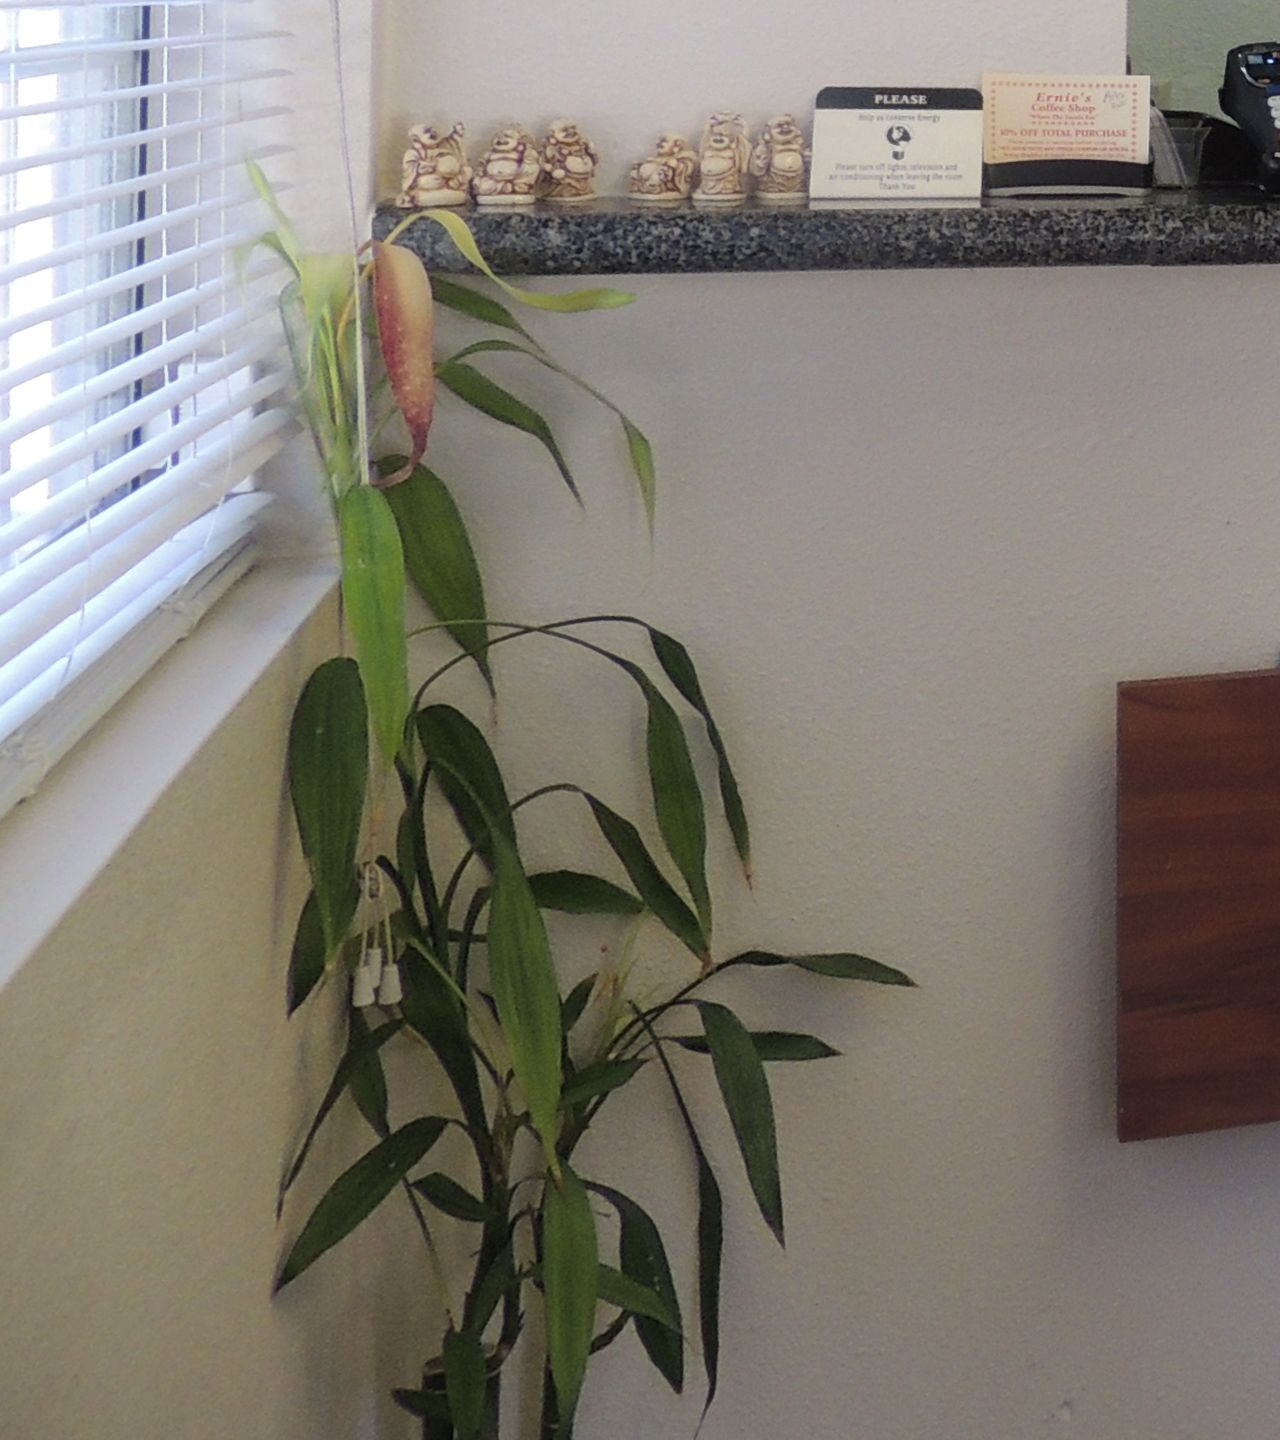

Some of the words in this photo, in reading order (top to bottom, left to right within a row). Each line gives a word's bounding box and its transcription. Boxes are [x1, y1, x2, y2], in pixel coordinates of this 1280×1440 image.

[874, 94, 928, 104] PLEASE
[1036, 92, 1092, 102] Ernie's
[1031, 103, 1065, 112] Coffee
[1068, 104, 1096, 114] Shop
[1020, 129, 1038, 137] OFF
[1042, 129, 1072, 137] TOTAL
[1075, 129, 1128, 137] PURCHASE
